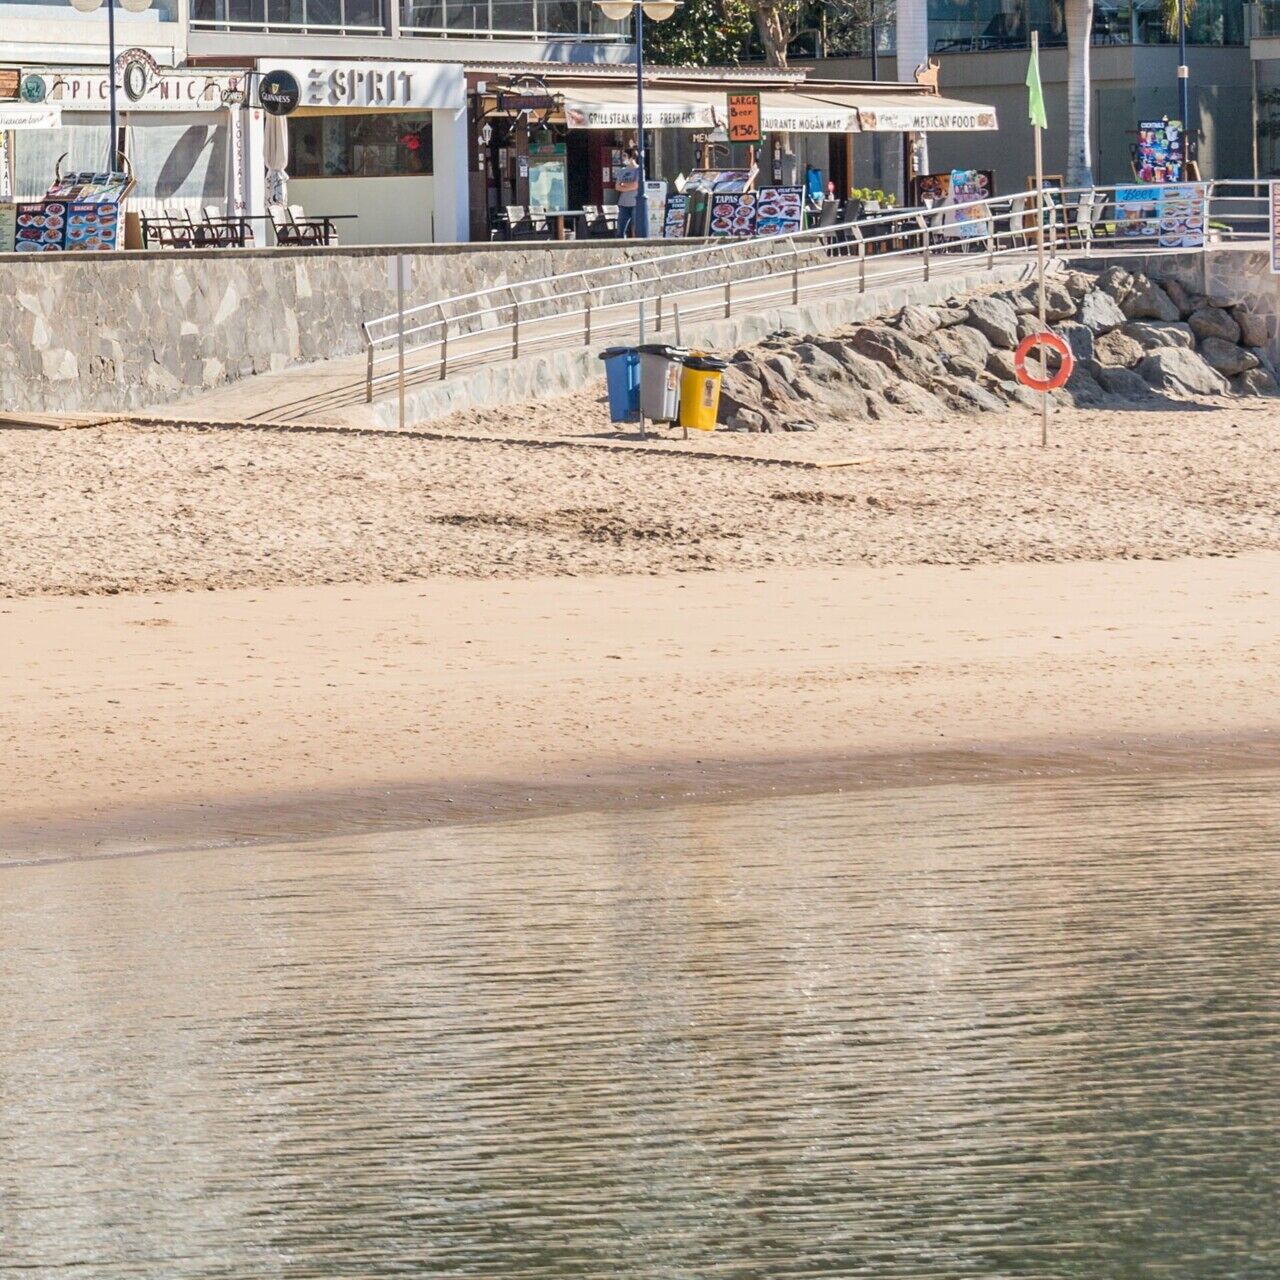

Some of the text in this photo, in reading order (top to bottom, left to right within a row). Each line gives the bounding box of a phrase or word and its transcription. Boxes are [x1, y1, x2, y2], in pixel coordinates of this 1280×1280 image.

[307, 67, 416, 106] ESPRIT
[261, 91, 291, 103] GUINNESS
[730, 96, 758, 105] LARGE
[730, 107, 753, 117] Beer
[609, 113, 631, 125] STEAK
[631, 113, 653, 124] HUSE
[659, 112, 681, 124] FRESH
[912, 115, 950, 128] MEXICAN
[951, 115, 976, 128] FOOD
[714, 195, 738, 204] TAPAS
[1122, 189, 1154, 201] Beer
